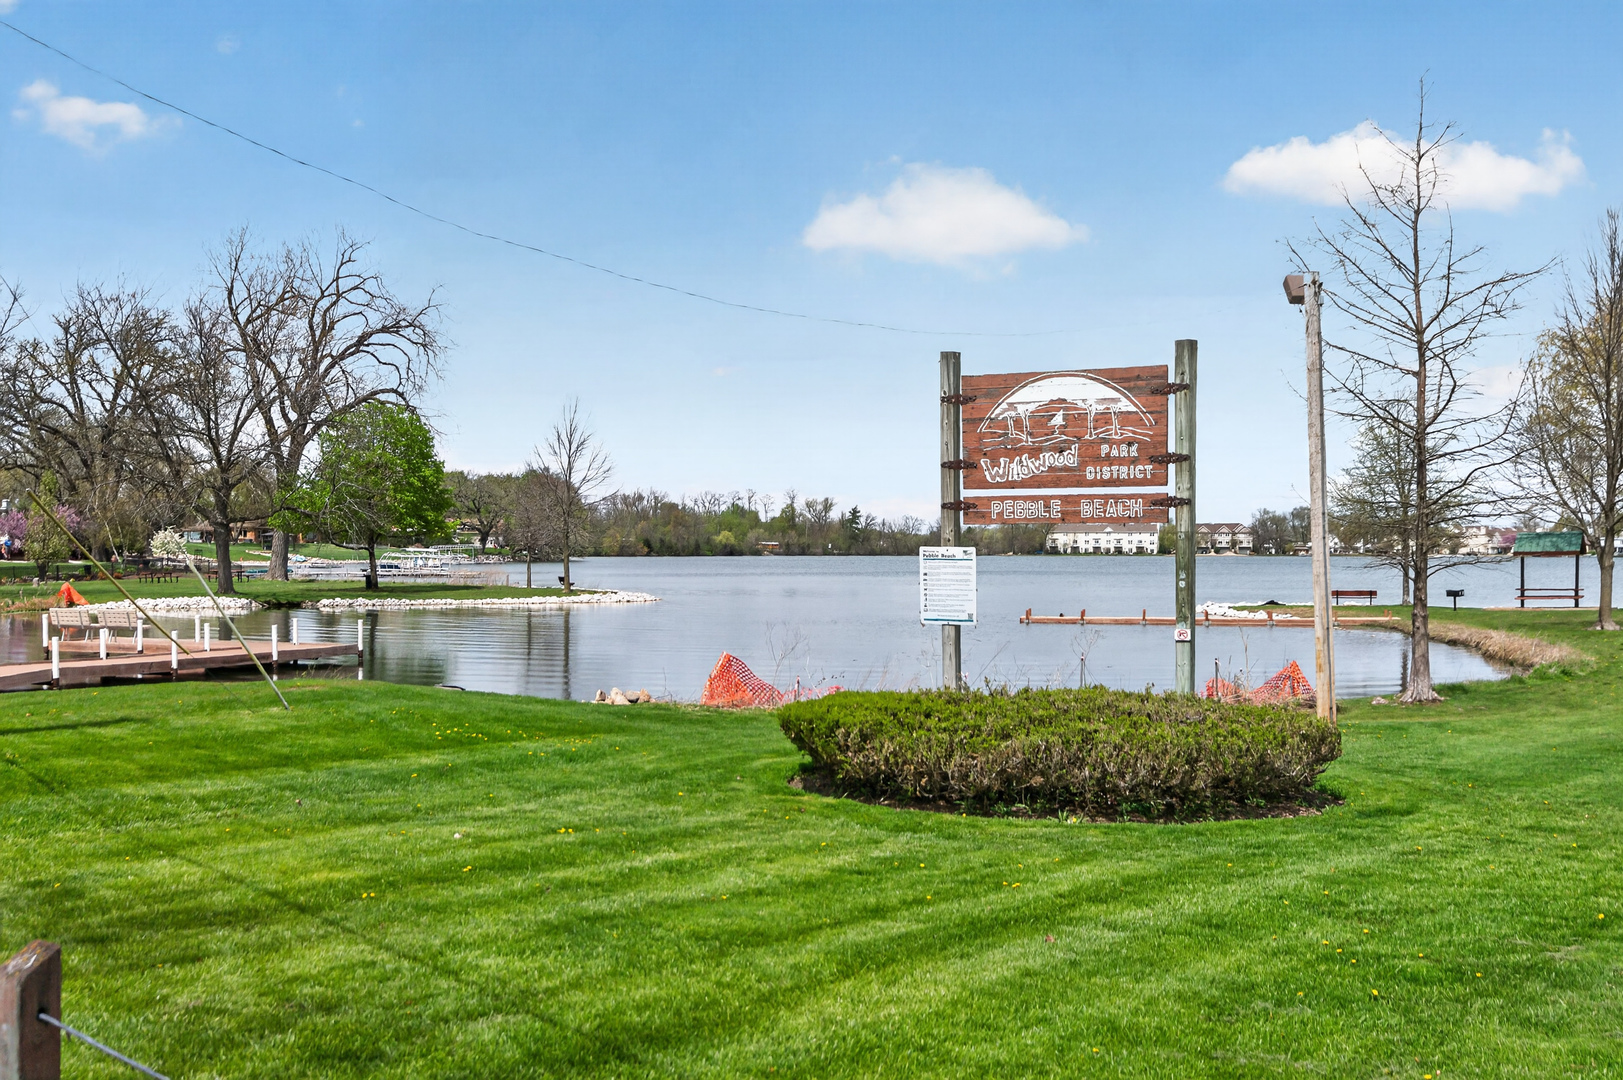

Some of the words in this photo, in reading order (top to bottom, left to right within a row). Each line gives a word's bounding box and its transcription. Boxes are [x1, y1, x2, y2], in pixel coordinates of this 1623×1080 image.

[1101, 444, 1139, 458] PARK
[980, 444, 1079, 483] Wildwood
[1086, 465, 1153, 480] DISTRICT
[991, 500, 1061, 519] PEBBLE
[1080, 499, 1143, 518] BEACH
